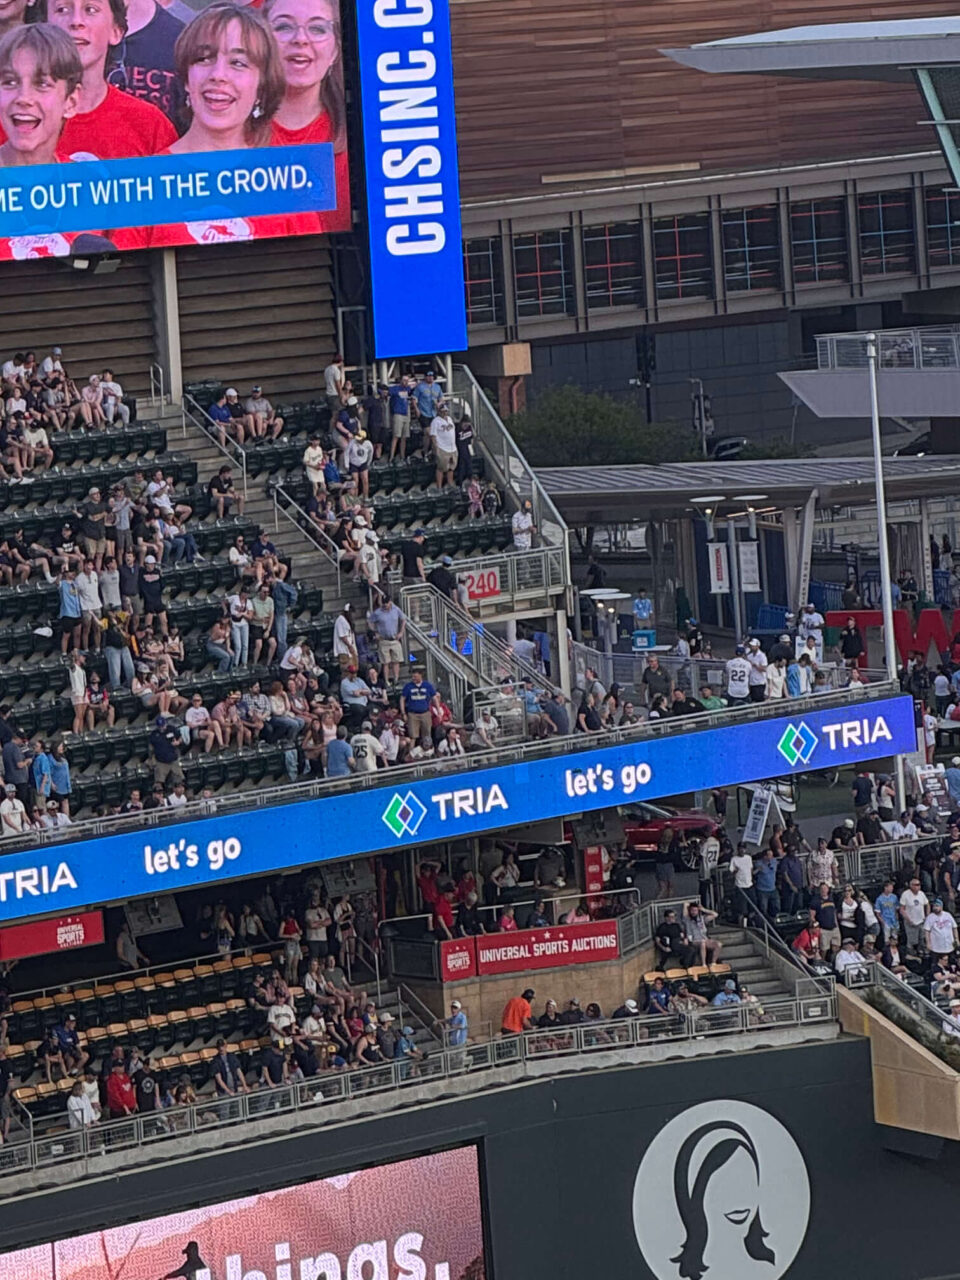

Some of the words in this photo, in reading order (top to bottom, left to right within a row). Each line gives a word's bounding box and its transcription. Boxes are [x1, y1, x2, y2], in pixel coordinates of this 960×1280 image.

[29, 182, 83, 209] OUT
[89, 176, 154, 206] WITH
[159, 172, 210, 200] THE
[216, 164, 314, 195] CROWD.
[466, 570, 498, 593] 240
[730, 668, 746, 682] 22
[821, 715, 894, 751] TRIA
[354, 744, 368, 759] 25
[565, 763, 615, 798] let's
[621, 762, 652, 794] go
[431, 783, 509, 821] TRIA
[143, 838, 199, 875] let's
[206, 836, 242, 871] go
[56, 930, 85, 945] SPORTS
[480, 945, 531, 964] UNIVERSAL
[533, 939, 570, 957] SPORTS
[571, 934, 617, 952] AUCTIONS
[447, 957, 471, 970] SPORTS
[195, 1231, 450, 1280] ings.
